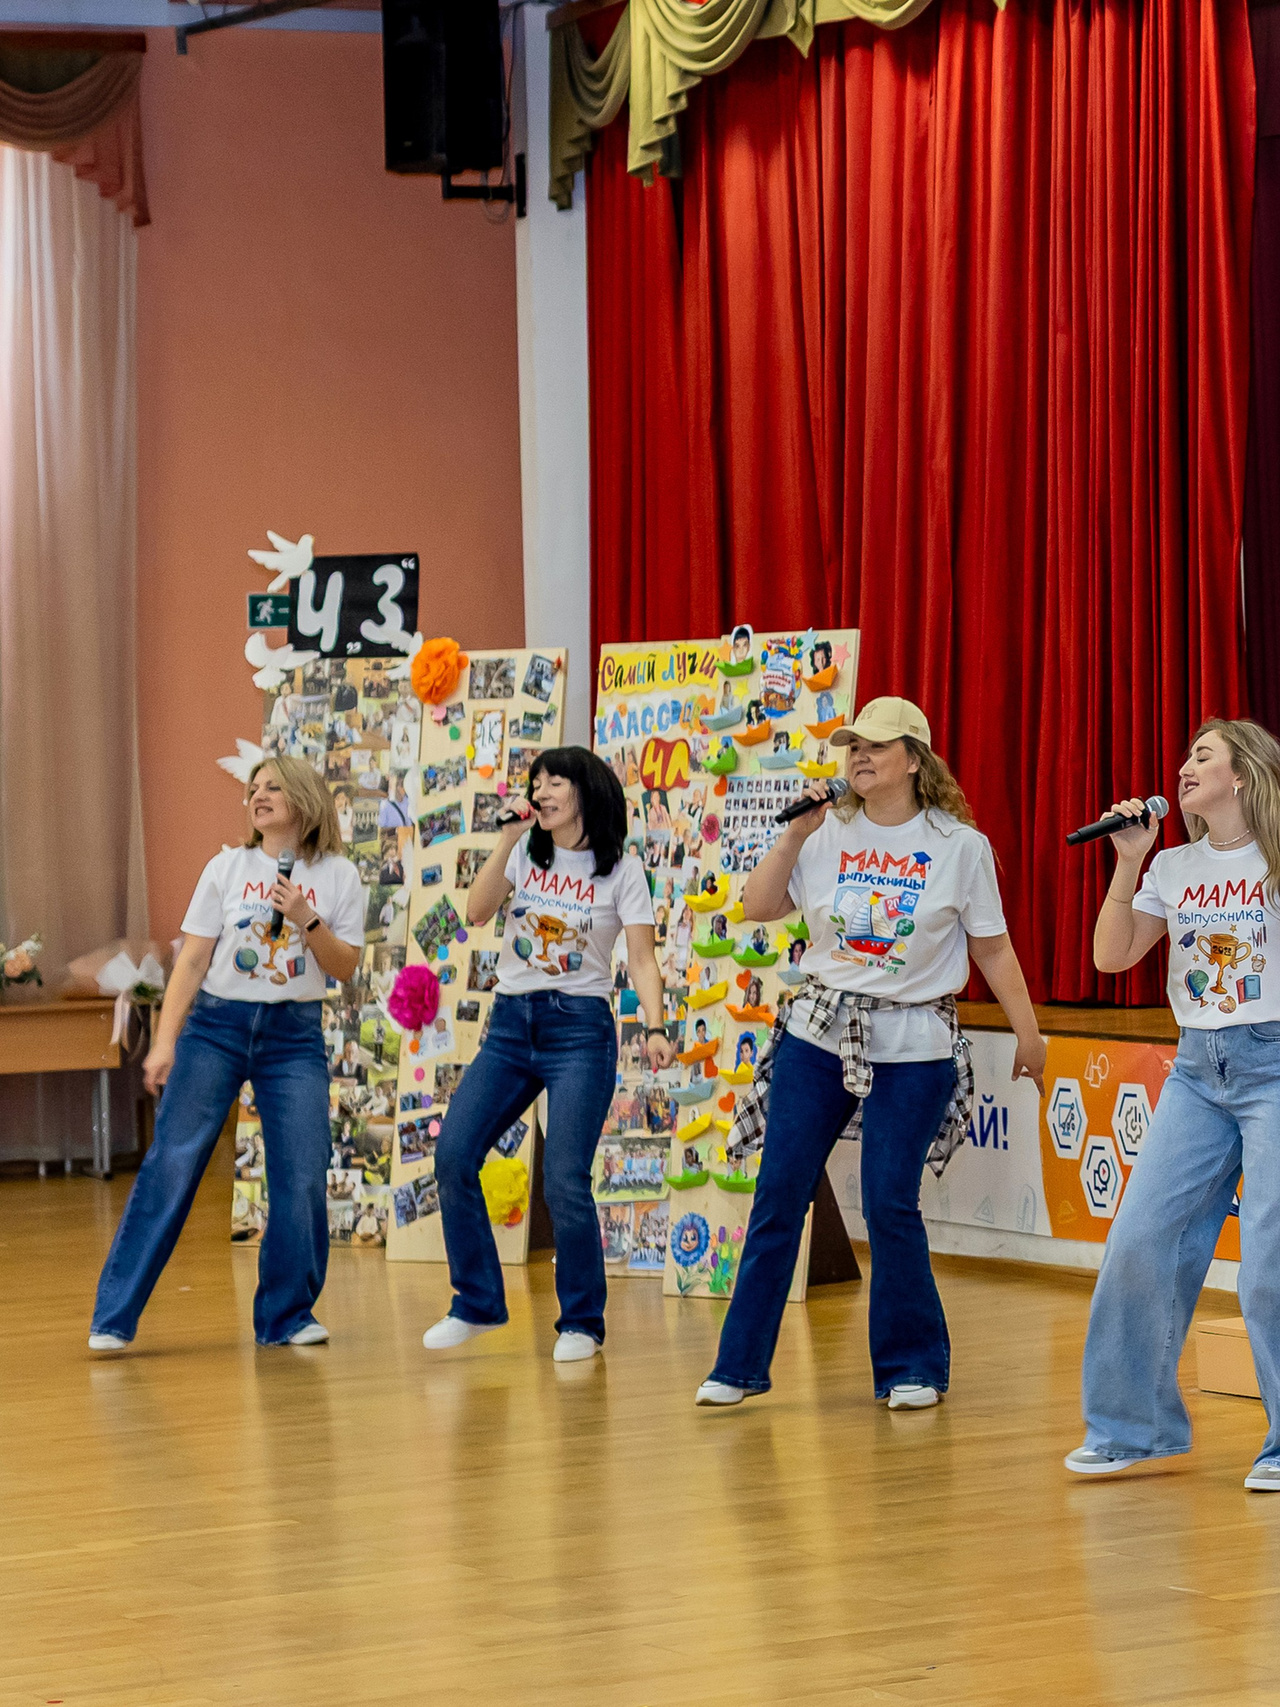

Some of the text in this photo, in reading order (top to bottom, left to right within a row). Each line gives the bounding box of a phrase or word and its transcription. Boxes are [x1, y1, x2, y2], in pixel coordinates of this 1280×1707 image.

[839, 848, 927, 879] МАМА
[242, 881, 317, 909] МА
[523, 867, 596, 905] МАМА
[901, 893, 916, 907] 25
[1177, 878, 1265, 909] МАМА
[966, 1093, 1009, 1151] АЙ!
